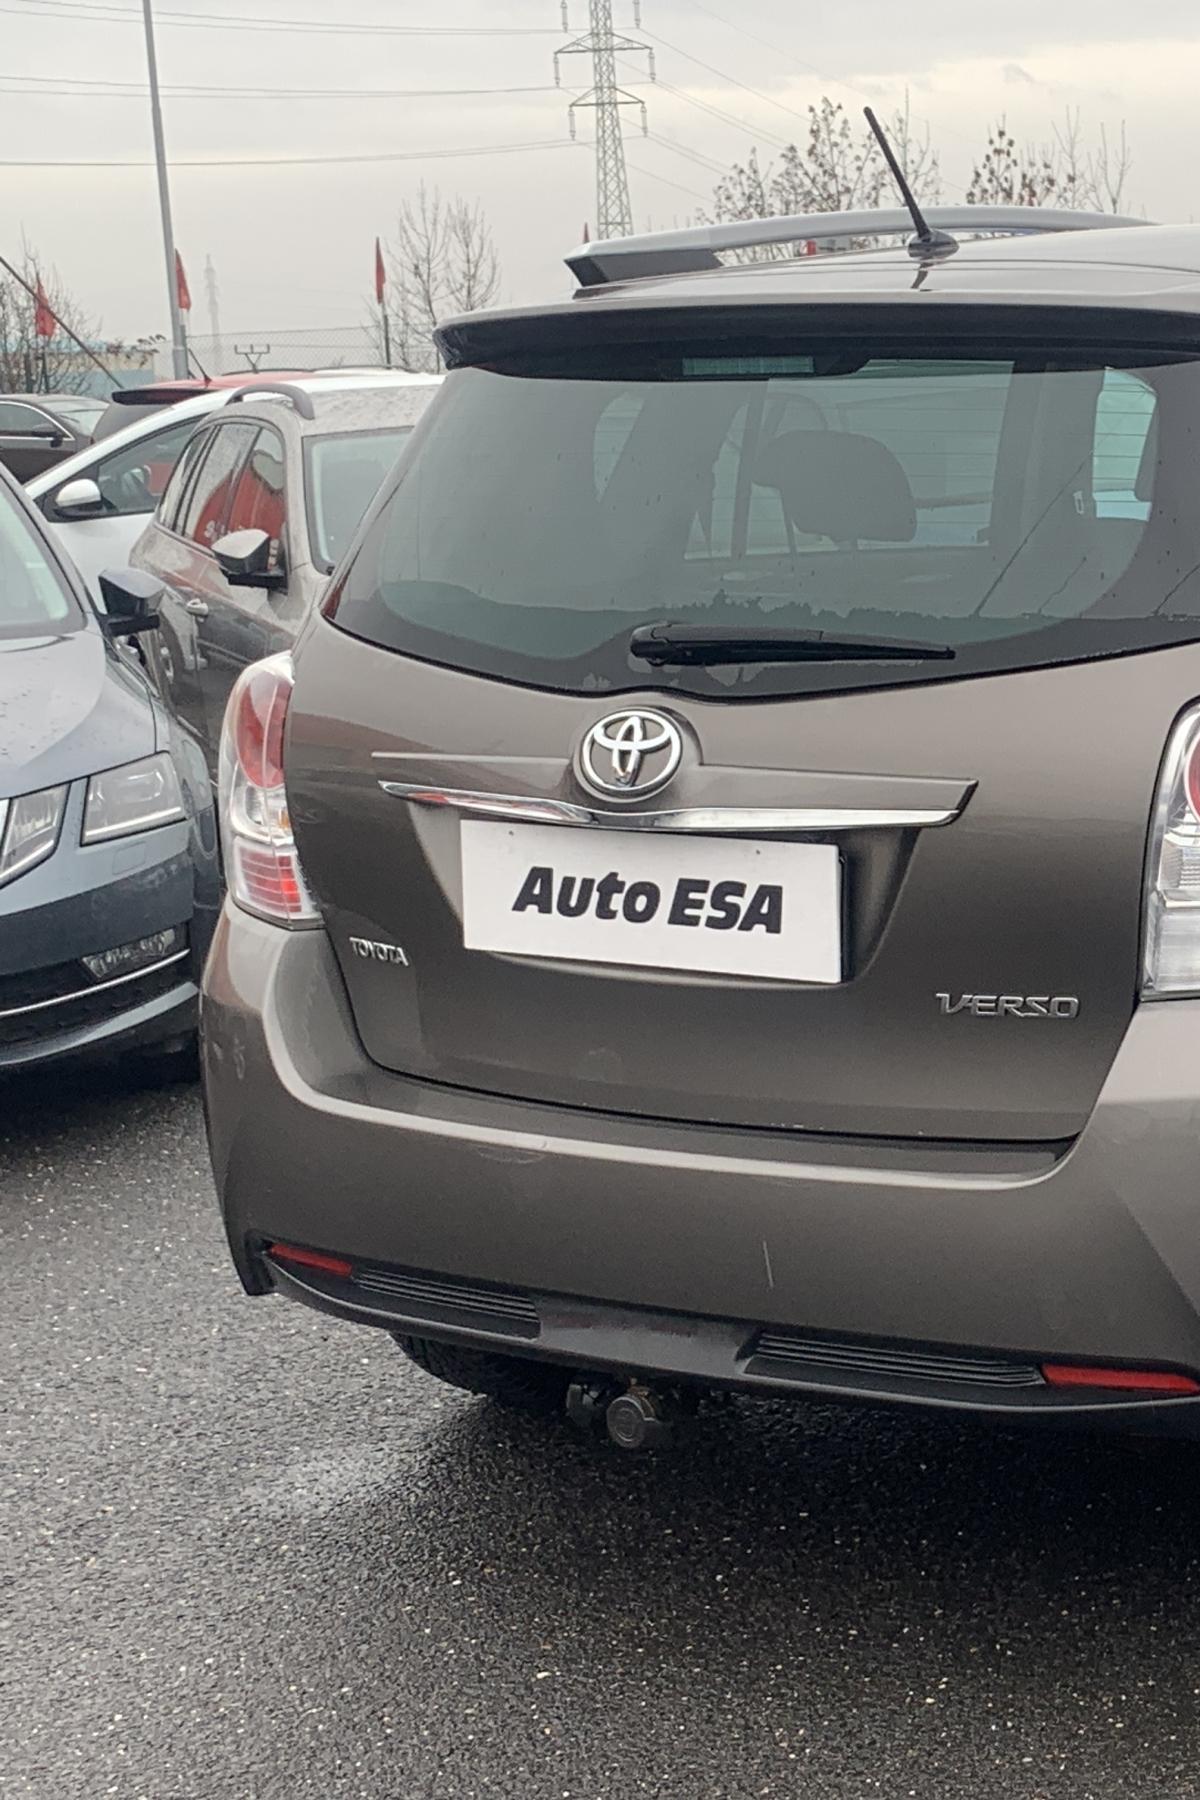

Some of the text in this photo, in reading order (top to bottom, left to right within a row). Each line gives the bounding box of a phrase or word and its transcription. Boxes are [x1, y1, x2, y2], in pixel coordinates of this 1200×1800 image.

[511, 866, 783, 934] Auto ESA
[349, 936, 409, 966] TOYOTA
[935, 993, 1079, 1018] VERSO
